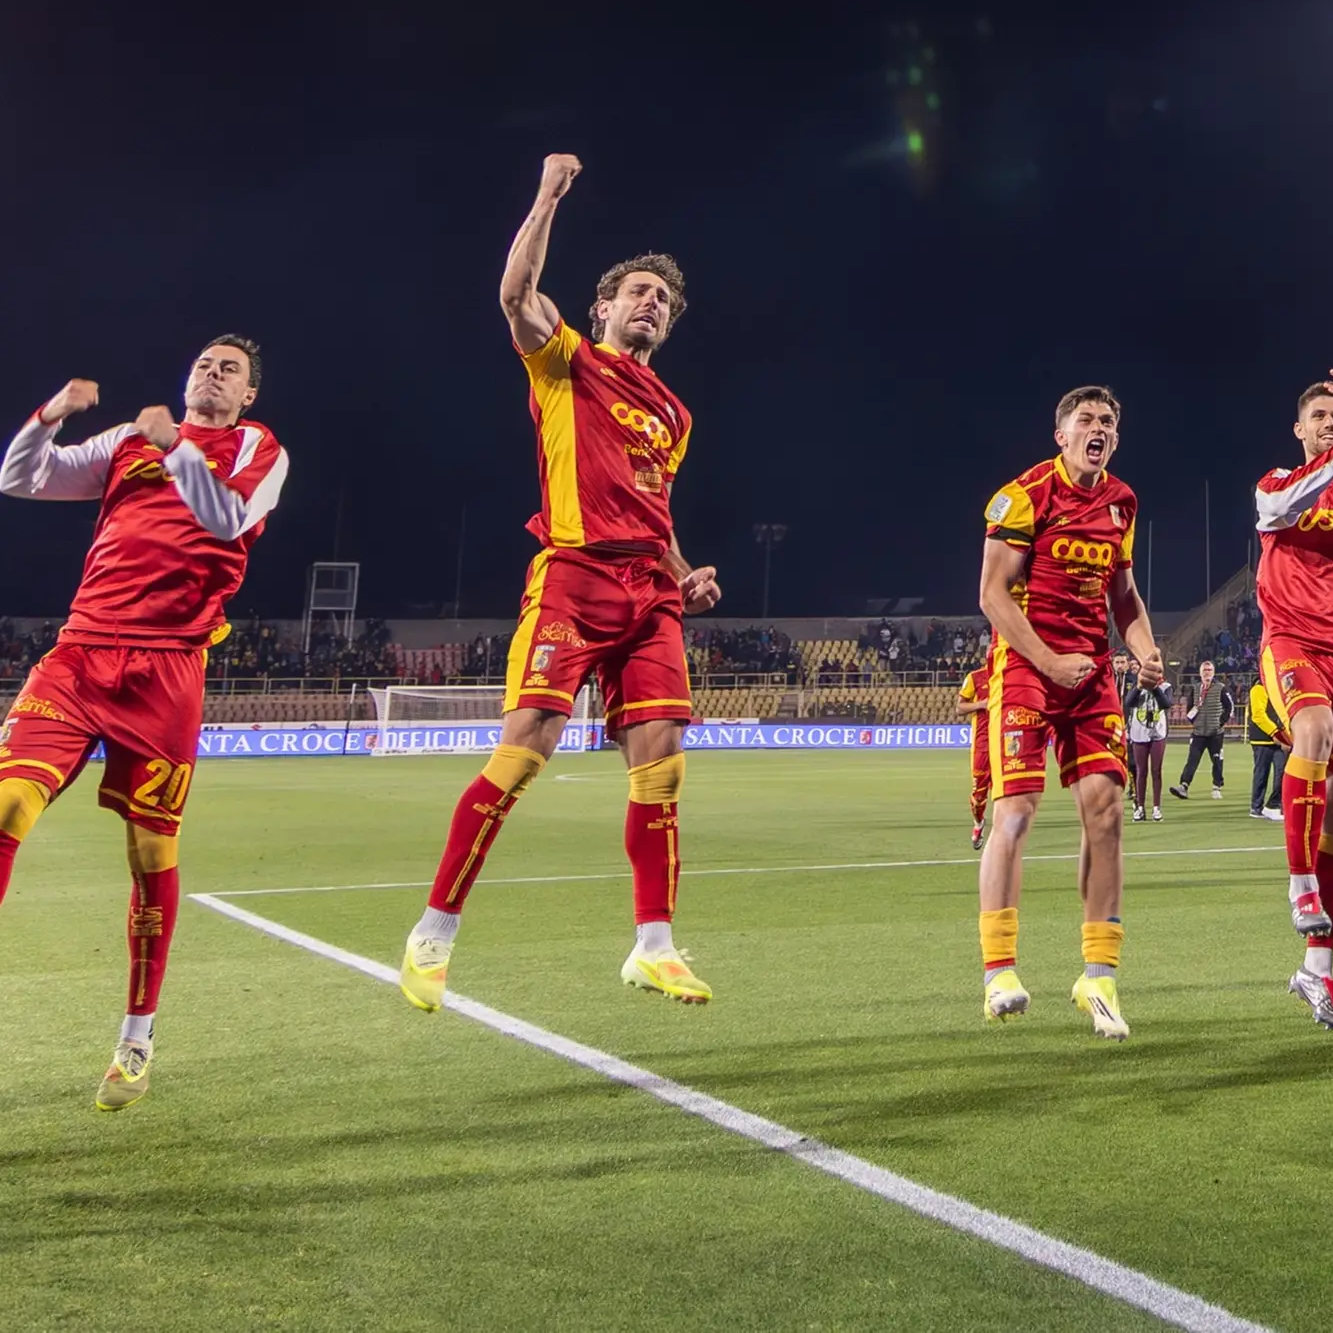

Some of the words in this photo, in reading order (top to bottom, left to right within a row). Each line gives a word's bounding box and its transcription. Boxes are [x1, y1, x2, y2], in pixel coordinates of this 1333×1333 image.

[1052, 537, 1113, 567] coop
[260, 732, 361, 753] CROCE
[686, 727, 767, 746] SANTA
[773, 727, 857, 746] CROCE
[875, 727, 955, 745] OFFICIAL
[133, 758, 193, 812] 20
